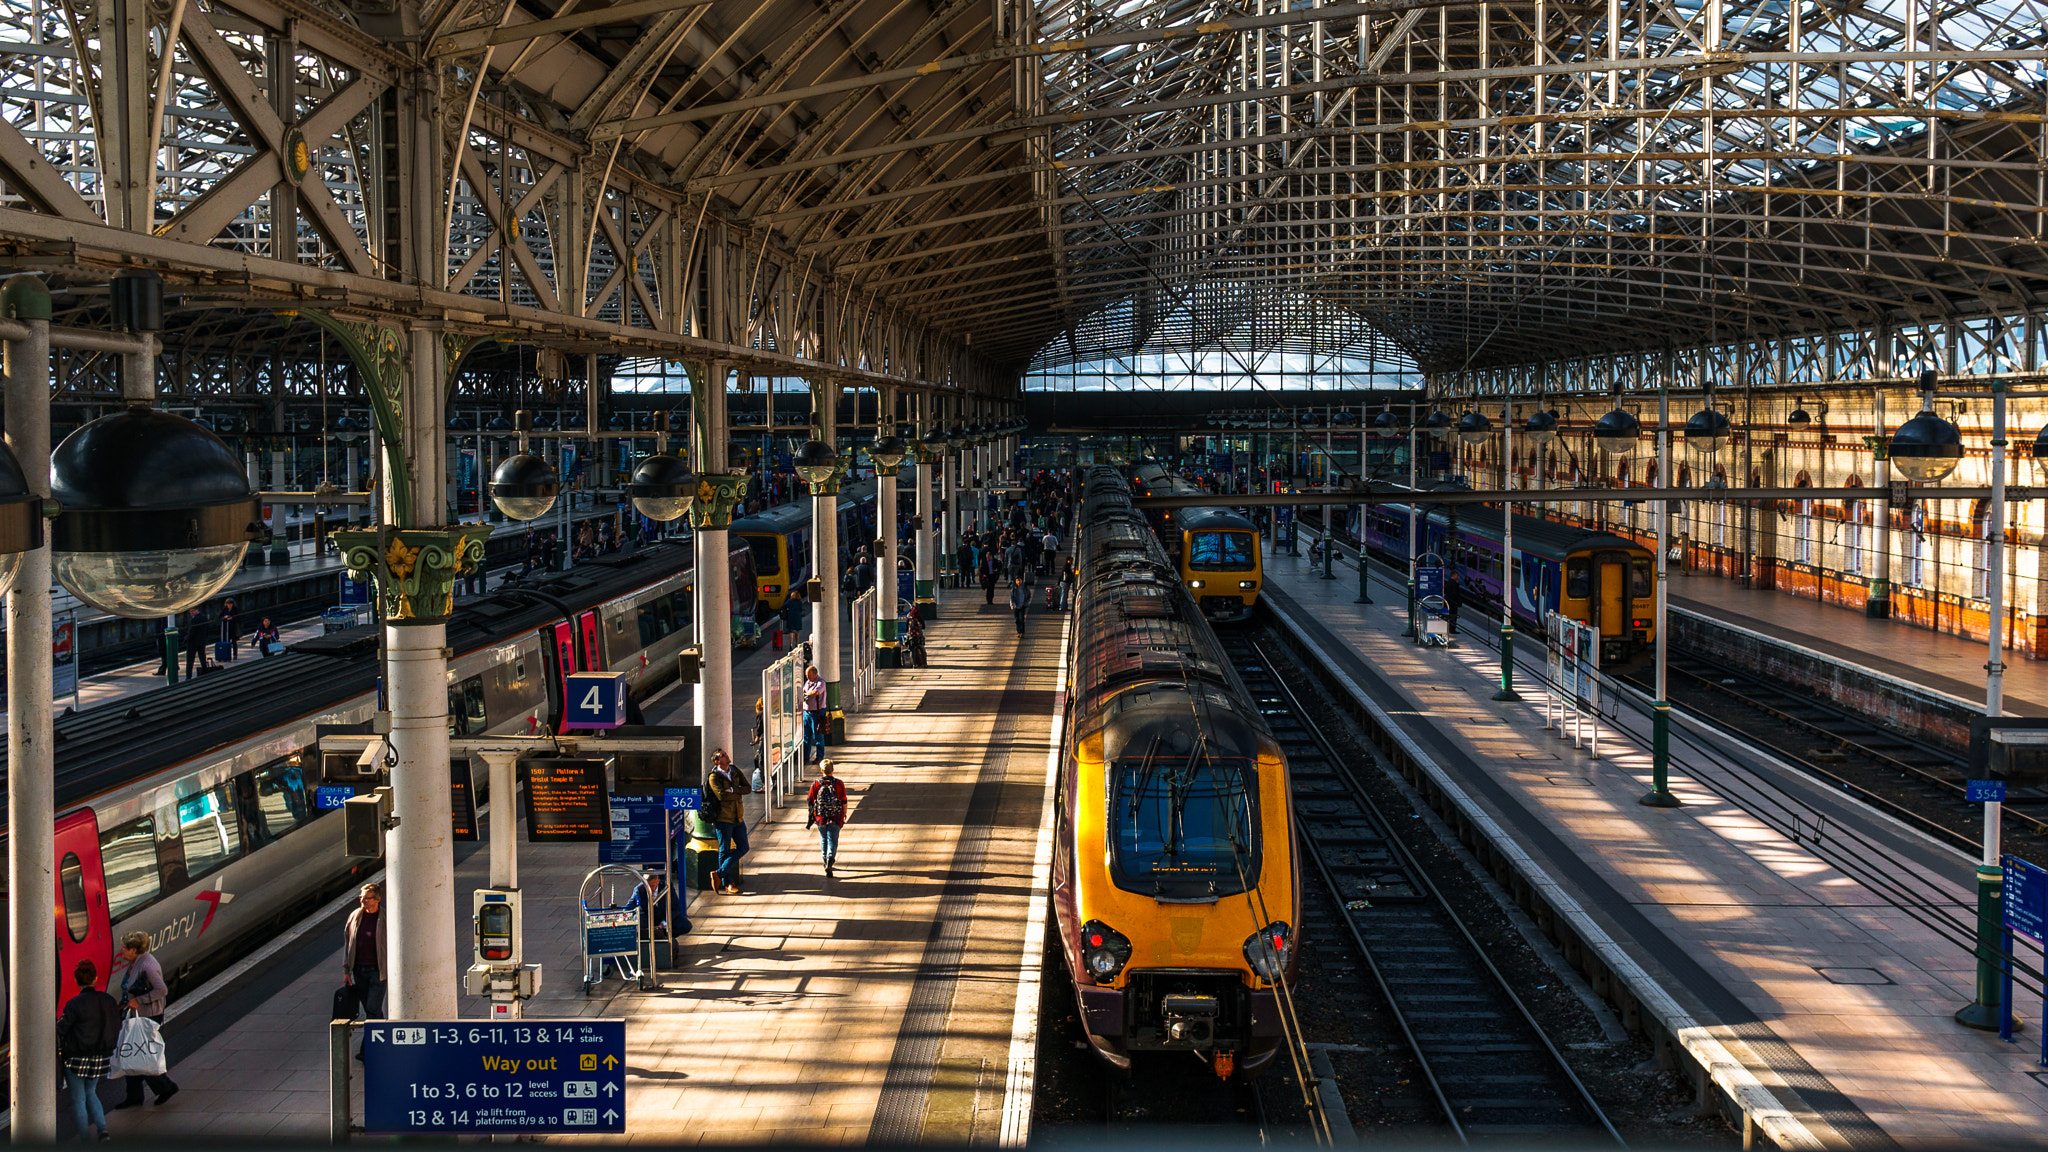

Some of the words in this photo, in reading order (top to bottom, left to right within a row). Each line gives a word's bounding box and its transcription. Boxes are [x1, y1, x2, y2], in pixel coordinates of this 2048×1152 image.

[580, 685, 603, 715] 4
[617, 682, 623, 711] 4
[326, 796, 346, 806] 364
[1976, 789, 1998, 800] 354
[672, 797, 693, 808] 362
[514, 1028, 531, 1043] 13
[537, 1028, 550, 1043] &
[556, 1028, 574, 1043] 14
[482, 1056, 520, 1074] Way
[526, 1056, 558, 1070] out
[528, 1080, 548, 1088] level
[410, 1083, 416, 1098] 1
[422, 1084, 440, 1098] to
[444, 1083, 460, 1100] 3,
[466, 1083, 476, 1098] 6
[482, 1084, 500, 1098] to
[505, 1083, 522, 1098] 12
[409, 1110, 426, 1126] 13
[432, 1110, 446, 1126] &
[450, 1110, 470, 1126] 14
[476, 1108, 488, 1116] via
[490, 1108, 502, 1116] lift
[505, 1108, 526, 1116] from
[476, 1116, 516, 1126] platforms
[520, 1116, 536, 1126] 8/9
[538, 1117, 545, 1125] &
[548, 1116, 558, 1125] 10
